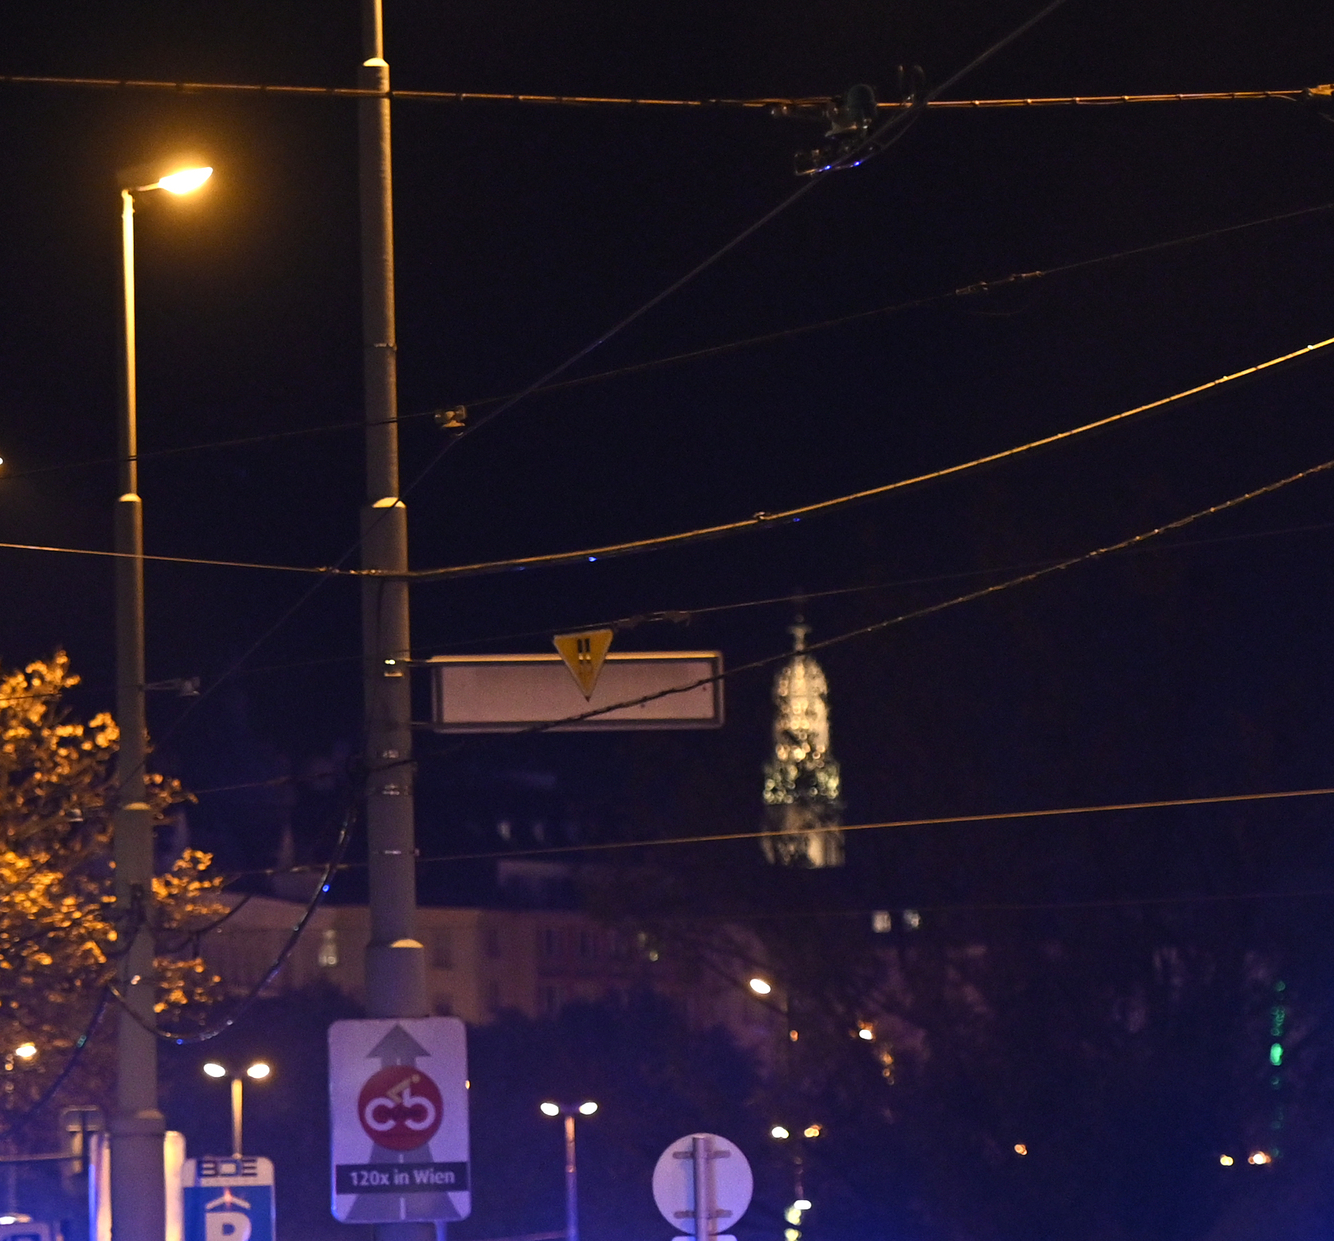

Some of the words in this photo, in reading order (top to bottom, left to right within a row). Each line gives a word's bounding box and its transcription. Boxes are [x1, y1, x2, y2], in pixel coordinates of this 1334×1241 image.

[350, 1171, 390, 1187] 120x
[394, 1169, 410, 1185] in
[413, 1168, 456, 1184] Wien
